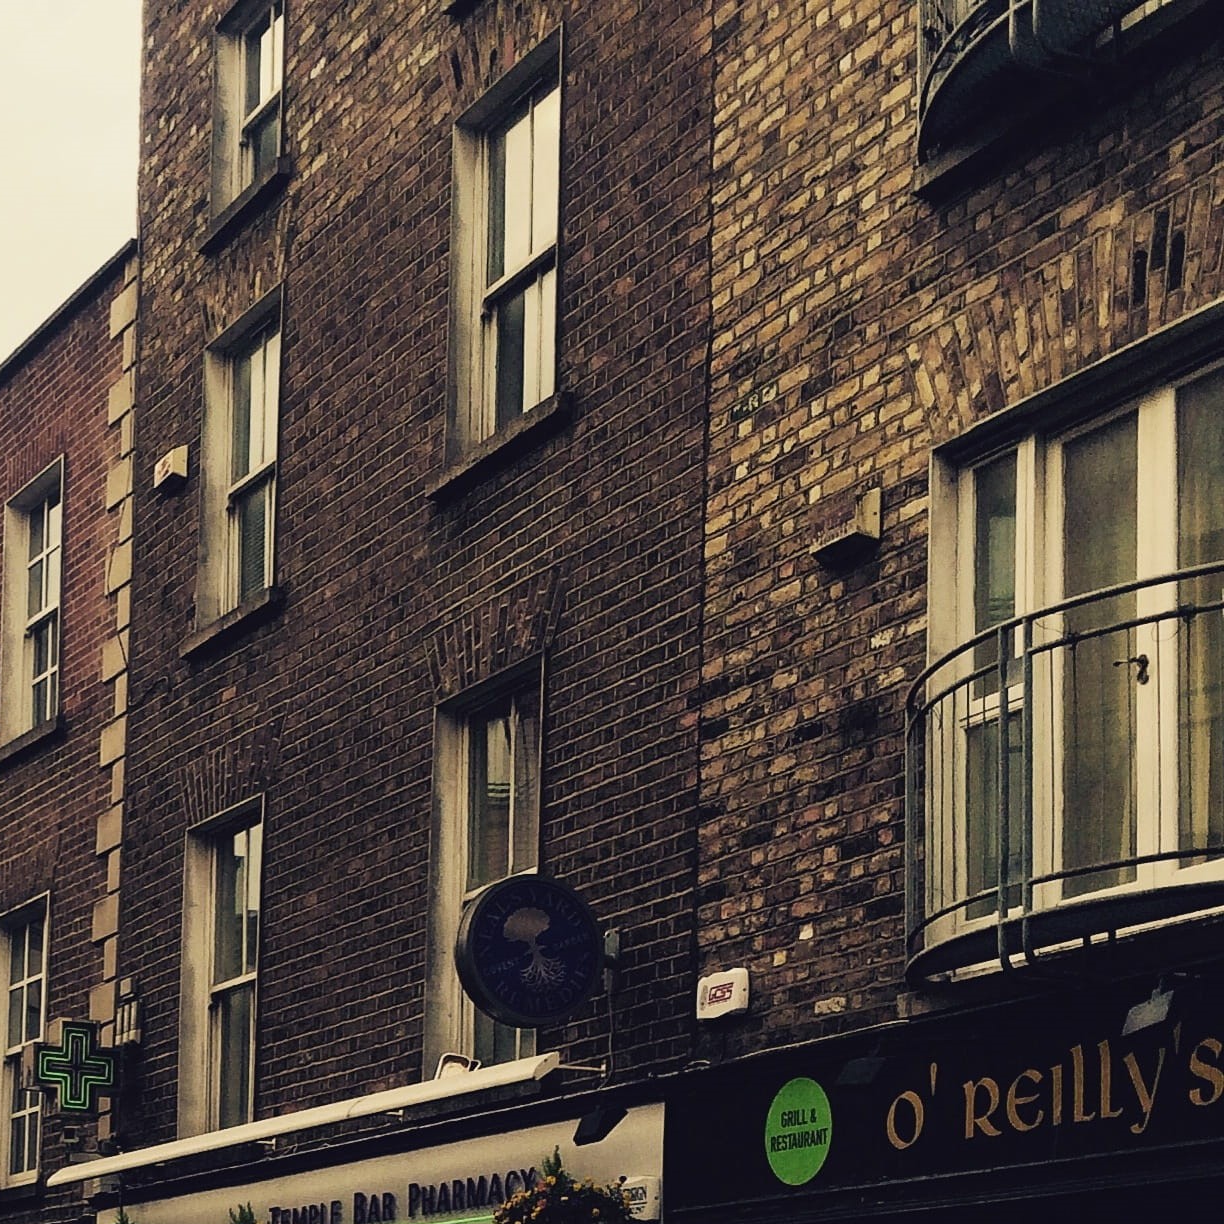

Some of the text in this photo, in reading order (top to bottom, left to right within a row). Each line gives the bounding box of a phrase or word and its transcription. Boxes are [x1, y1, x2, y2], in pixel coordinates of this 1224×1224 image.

[780, 1107, 818, 1128] GRILL &
[770, 1127, 829, 1153] RESTAURANT
[407, 1166, 537, 1219] PHARMACY
